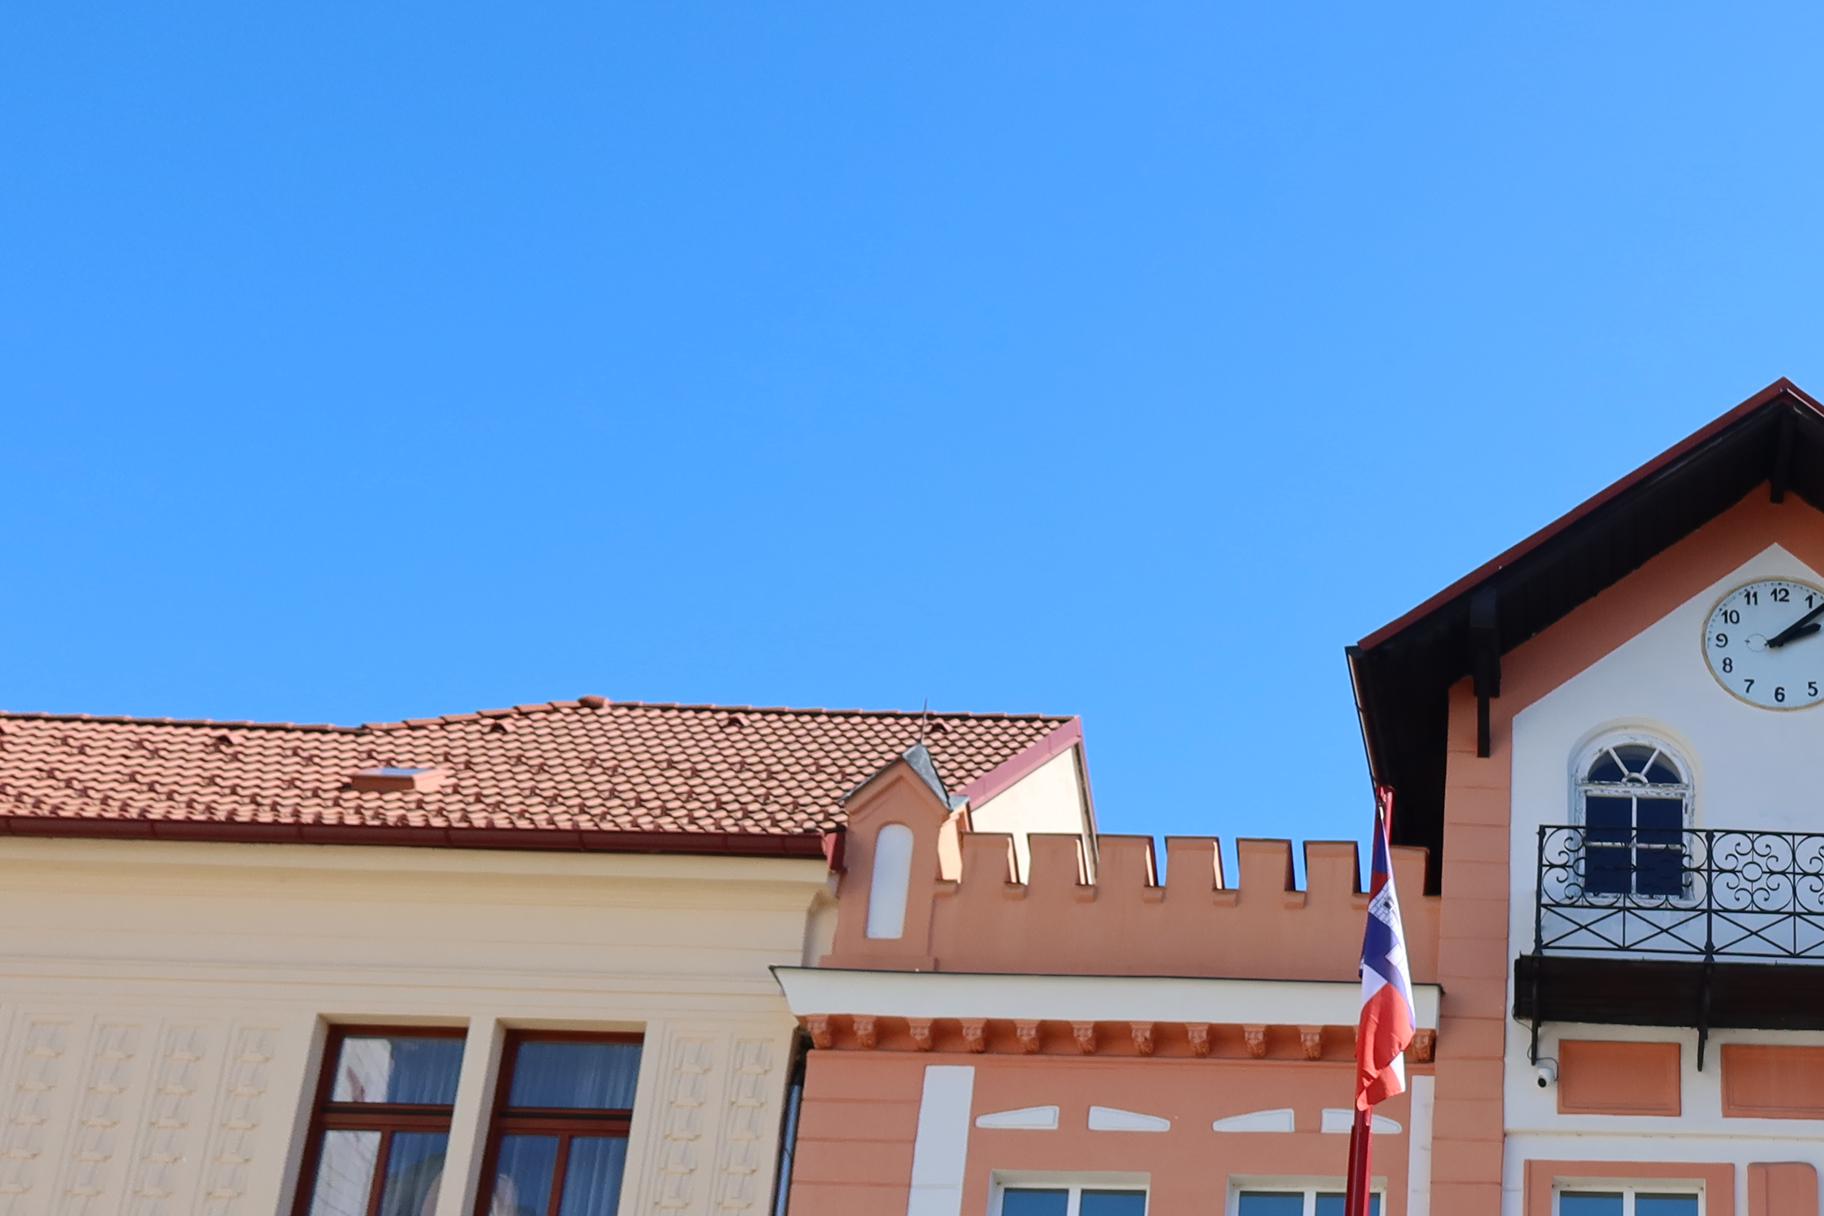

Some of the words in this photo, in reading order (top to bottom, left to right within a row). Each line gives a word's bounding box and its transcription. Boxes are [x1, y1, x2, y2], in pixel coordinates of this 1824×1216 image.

[1744, 591, 1758, 606] 11
[1770, 588, 1790, 602] 12
[1805, 594, 1814, 609] 1
[1721, 610, 1740, 624] 10
[1715, 633, 1728, 648] 9
[1722, 657, 1733, 673] 8
[1744, 679, 1755, 694] 7
[1807, 682, 1818, 697] 5
[1774, 687, 1786, 702] 6
